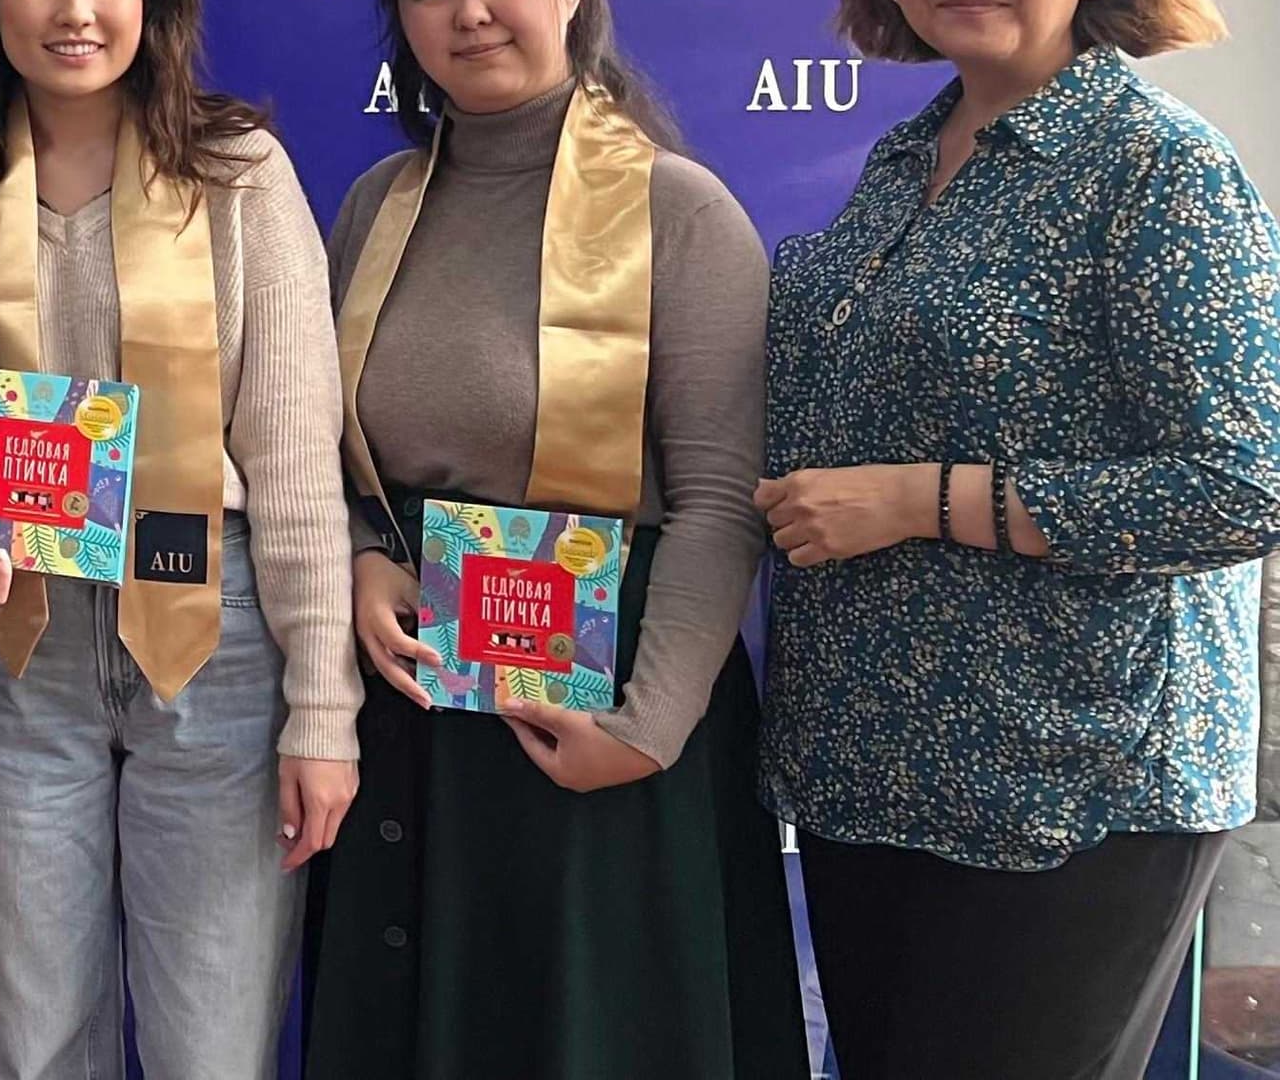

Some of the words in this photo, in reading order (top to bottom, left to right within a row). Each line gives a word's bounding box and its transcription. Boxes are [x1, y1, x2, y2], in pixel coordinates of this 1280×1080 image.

[745, 58, 863, 112] AIU
[5, 435, 71, 461] КЕДРОВАЯ
[3, 455, 69, 487] ПТИЧКА
[150, 551, 194, 573] AIU
[482, 575, 552, 601] КЕДРОВАЯ
[481, 596, 552, 628] ПТИЧКА
